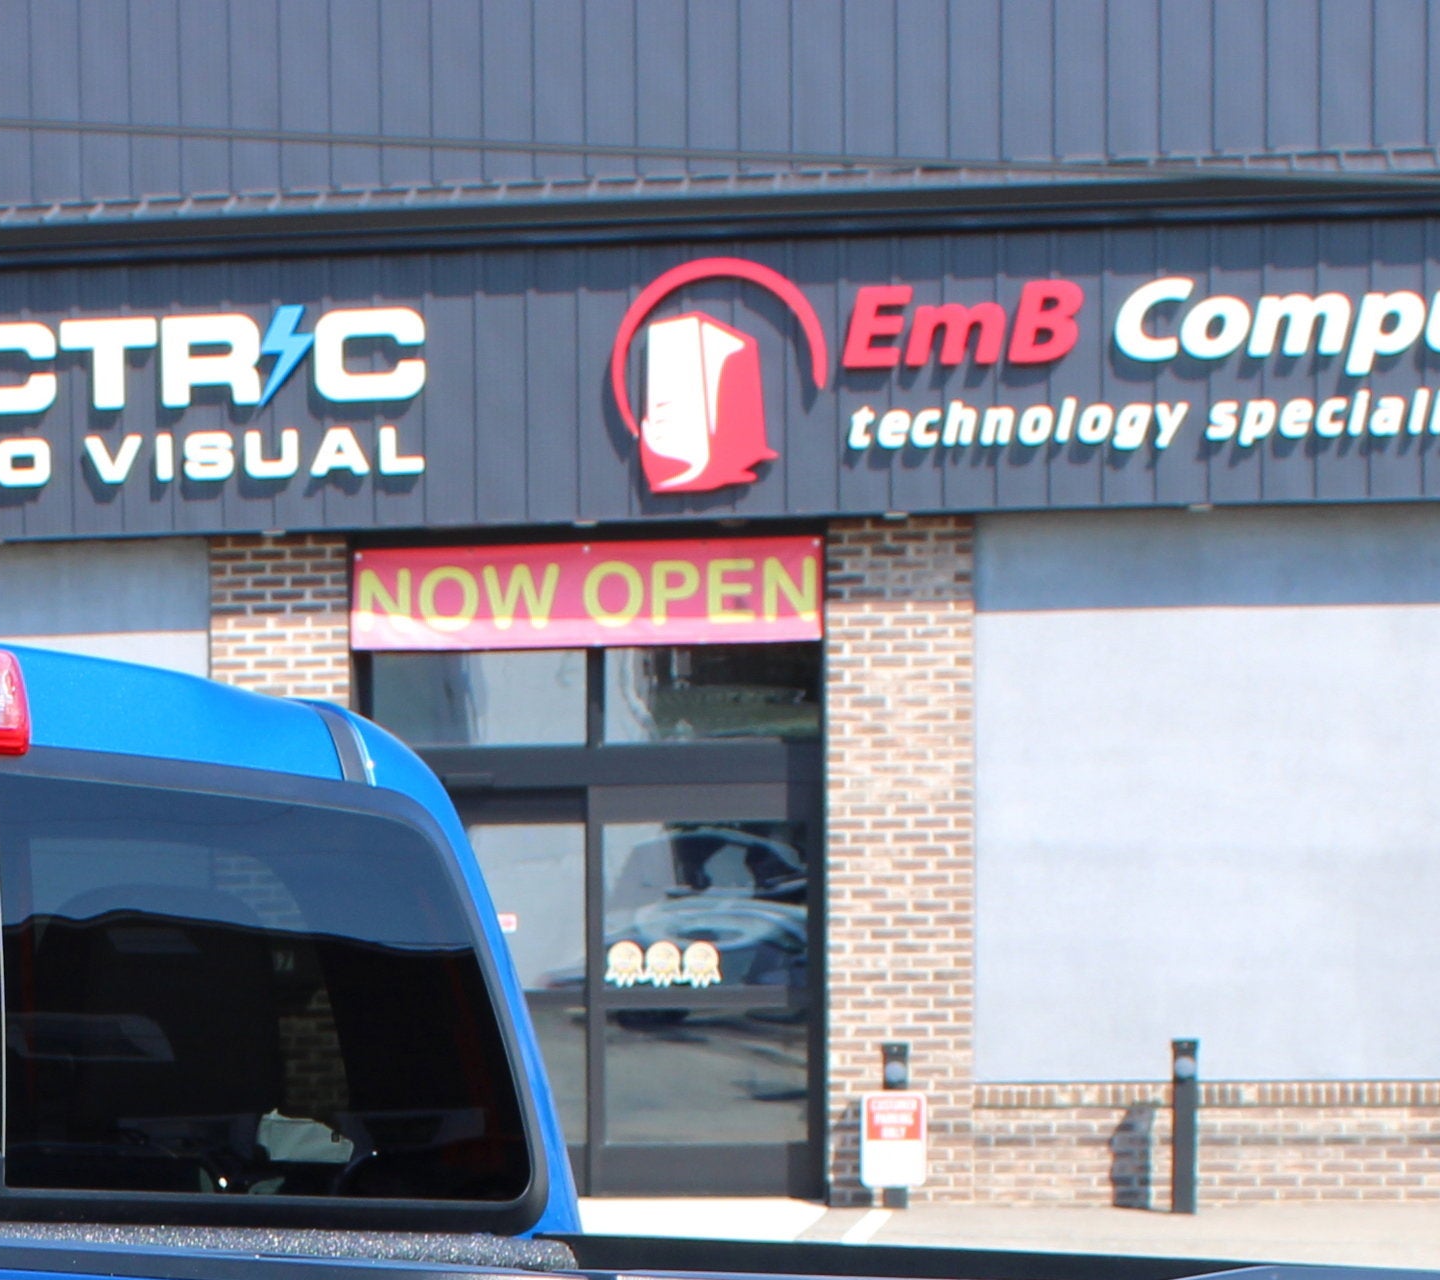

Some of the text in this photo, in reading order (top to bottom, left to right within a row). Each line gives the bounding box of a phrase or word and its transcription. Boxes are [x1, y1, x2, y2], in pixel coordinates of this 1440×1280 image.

[841, 279, 1085, 371] EmB
[84, 425, 426, 484] VISUAL
[848, 391, 1188, 454] technology
[357, 555, 817, 634] NOW OPEN
